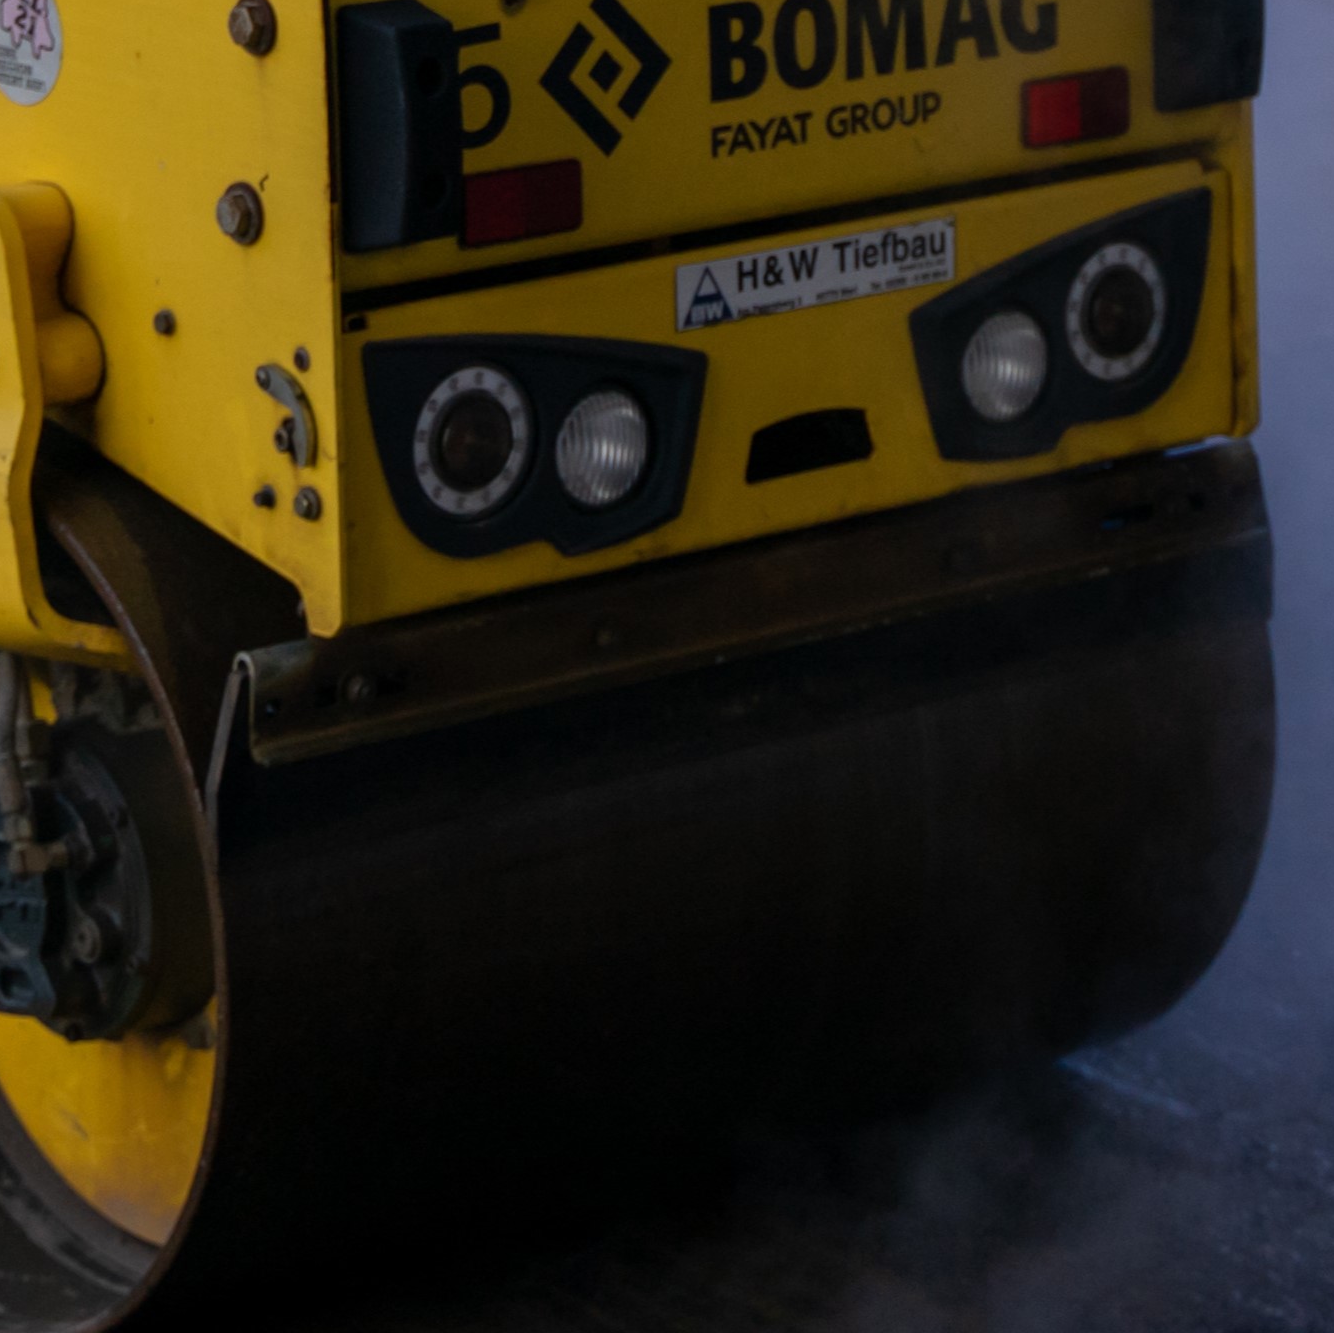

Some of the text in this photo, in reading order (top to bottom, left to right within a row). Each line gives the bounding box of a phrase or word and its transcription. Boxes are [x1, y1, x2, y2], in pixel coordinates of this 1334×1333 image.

[711, 91, 941, 158] FAYAT GROUP
[737, 247, 818, 293] H&W
[833, 230, 946, 274] Tiefbau
